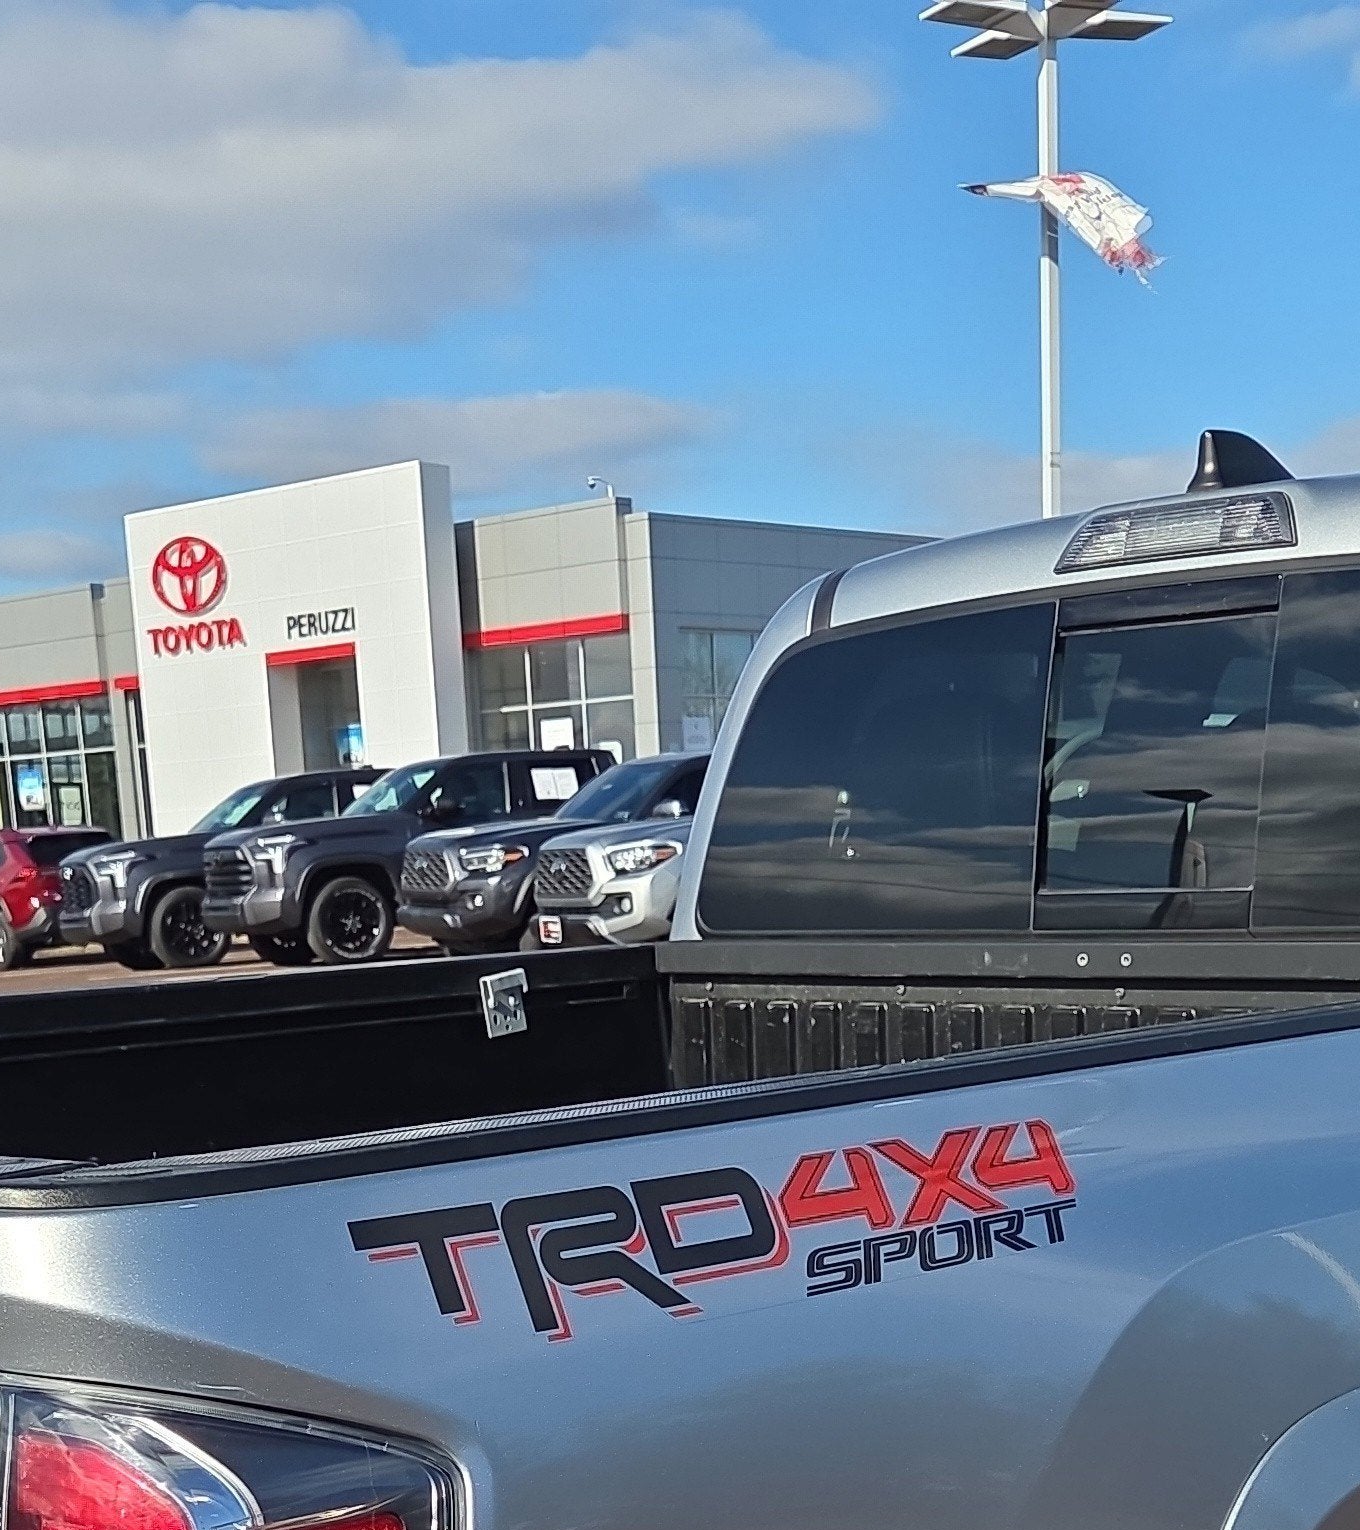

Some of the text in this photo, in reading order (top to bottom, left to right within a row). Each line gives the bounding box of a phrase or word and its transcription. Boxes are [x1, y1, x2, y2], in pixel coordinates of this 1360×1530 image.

[147, 618, 247, 659] TOYOTA
[287, 607, 356, 640] PERUZZI
[346, 1166, 790, 1343] TRD
[806, 1200, 1077, 1297] SPORT
